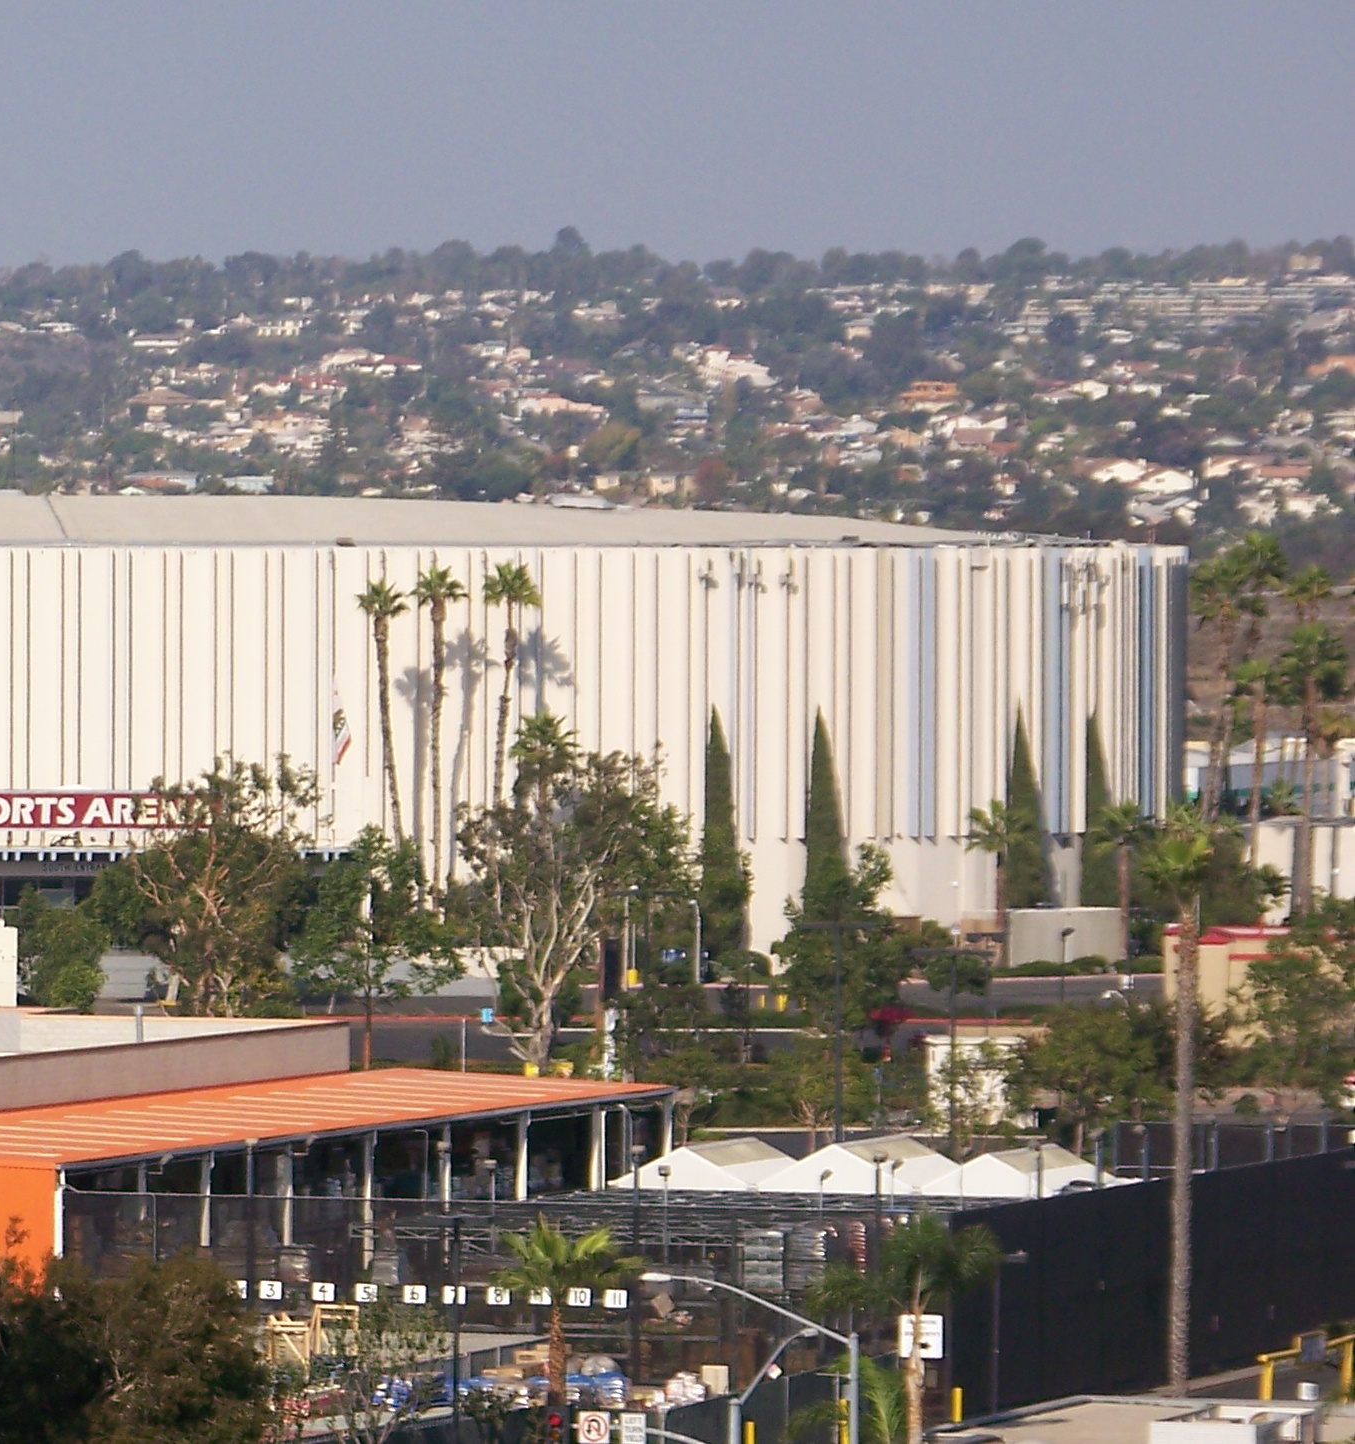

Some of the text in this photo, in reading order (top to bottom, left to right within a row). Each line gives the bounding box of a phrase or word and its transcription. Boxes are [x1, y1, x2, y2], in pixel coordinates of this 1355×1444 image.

[266, 1283, 275, 1298] 3
[318, 1284, 328, 1301] 4
[361, 1286, 372, 1300] 5
[409, 1286, 420, 1301] 6
[494, 1288, 504, 1302] 8
[573, 1290, 587, 1304] 10
[612, 1292, 622, 1306] 11
